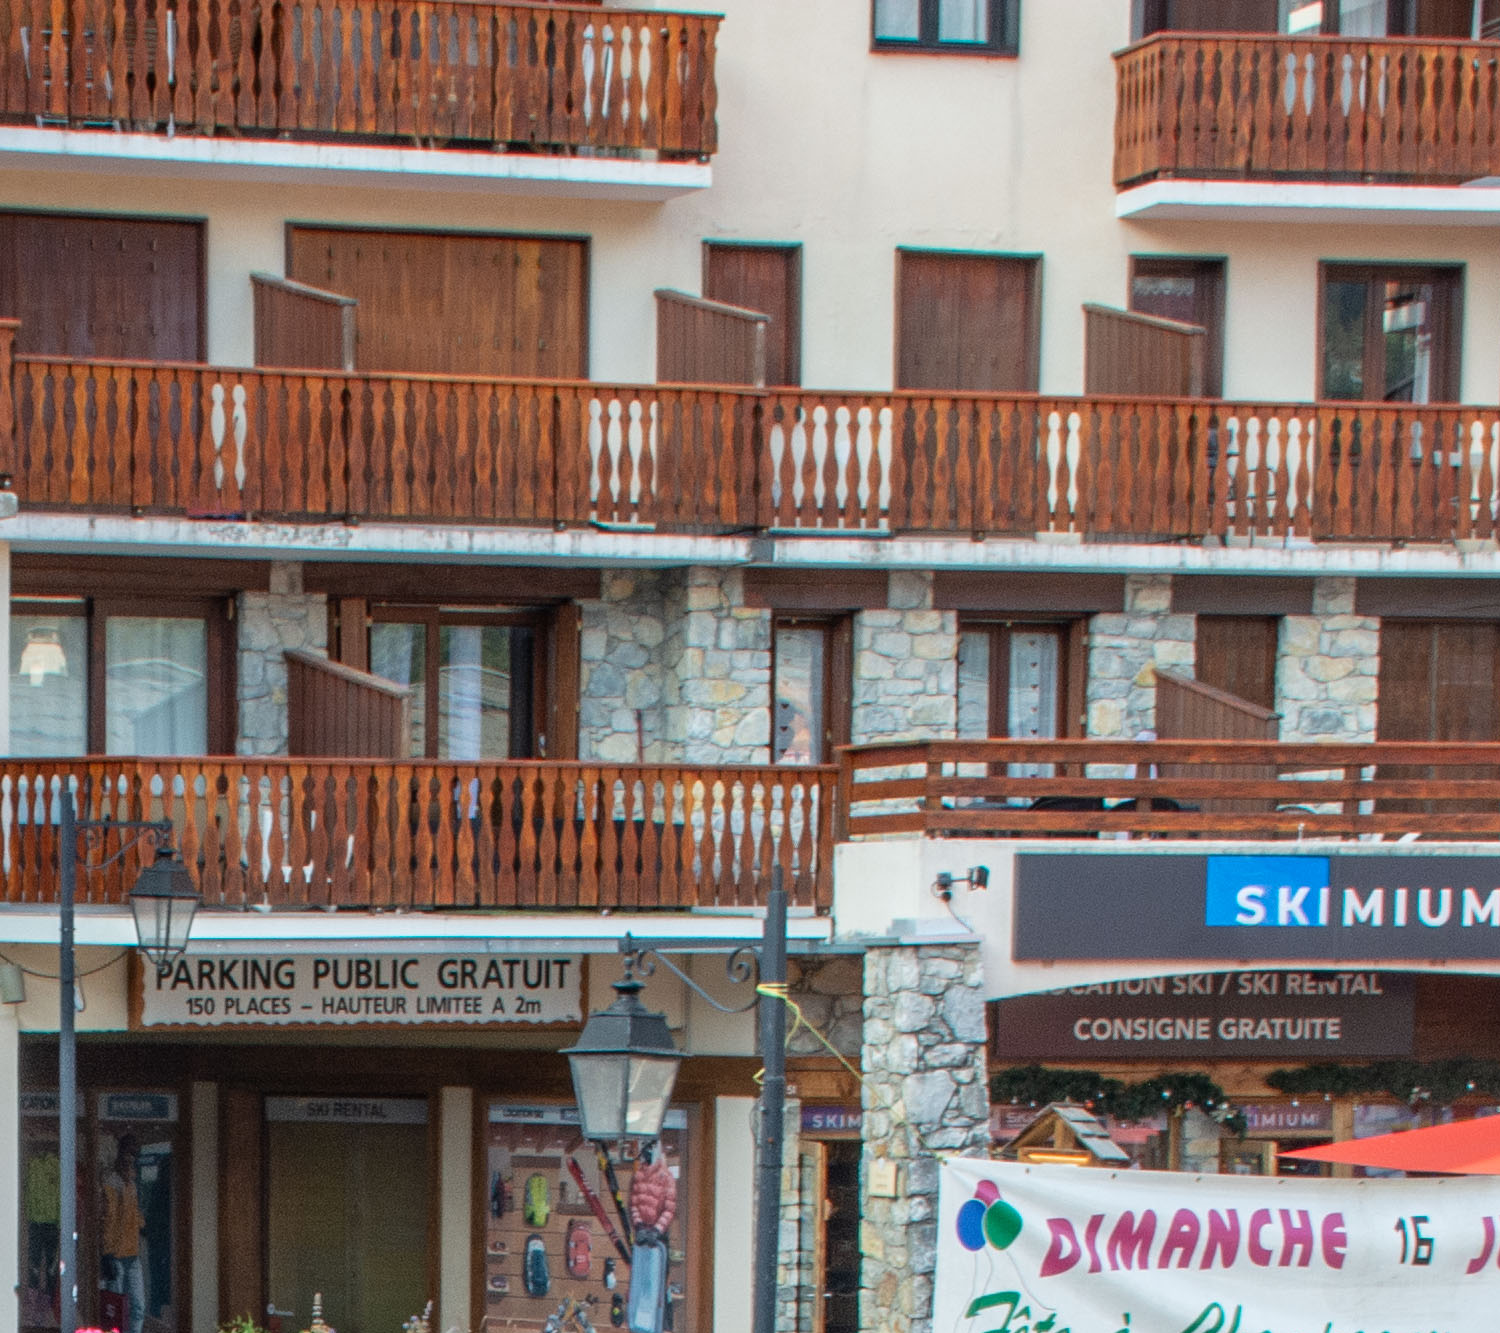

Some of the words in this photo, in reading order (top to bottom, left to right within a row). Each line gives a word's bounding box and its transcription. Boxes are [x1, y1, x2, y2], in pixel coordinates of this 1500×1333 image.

[156, 961, 293, 991] PARKING
[312, 962, 419, 990] PUBLIC
[437, 960, 572, 989] GRATUIT
[1172, 974, 1213, 996] SKI
[1237, 974, 1278, 996] SKI
[1285, 973, 1383, 996] RENTAL
[187, 997, 218, 1016] 150
[223, 997, 292, 1016] PLACES
[321, 997, 409, 1016] HAUTEUR
[416, 997, 487, 1016] LIMITEE
[491, 997, 508, 1016] A
[514, 997, 543, 1016] 2m
[1072, 1017, 1211, 1041] CONSIGNE
[1217, 1017, 1343, 1041] GRATUITE
[338, 1100, 388, 1118] RENTAL
[1040, 1206, 1349, 1278] DIMANCHE
[1397, 1215, 1435, 1266] 16
